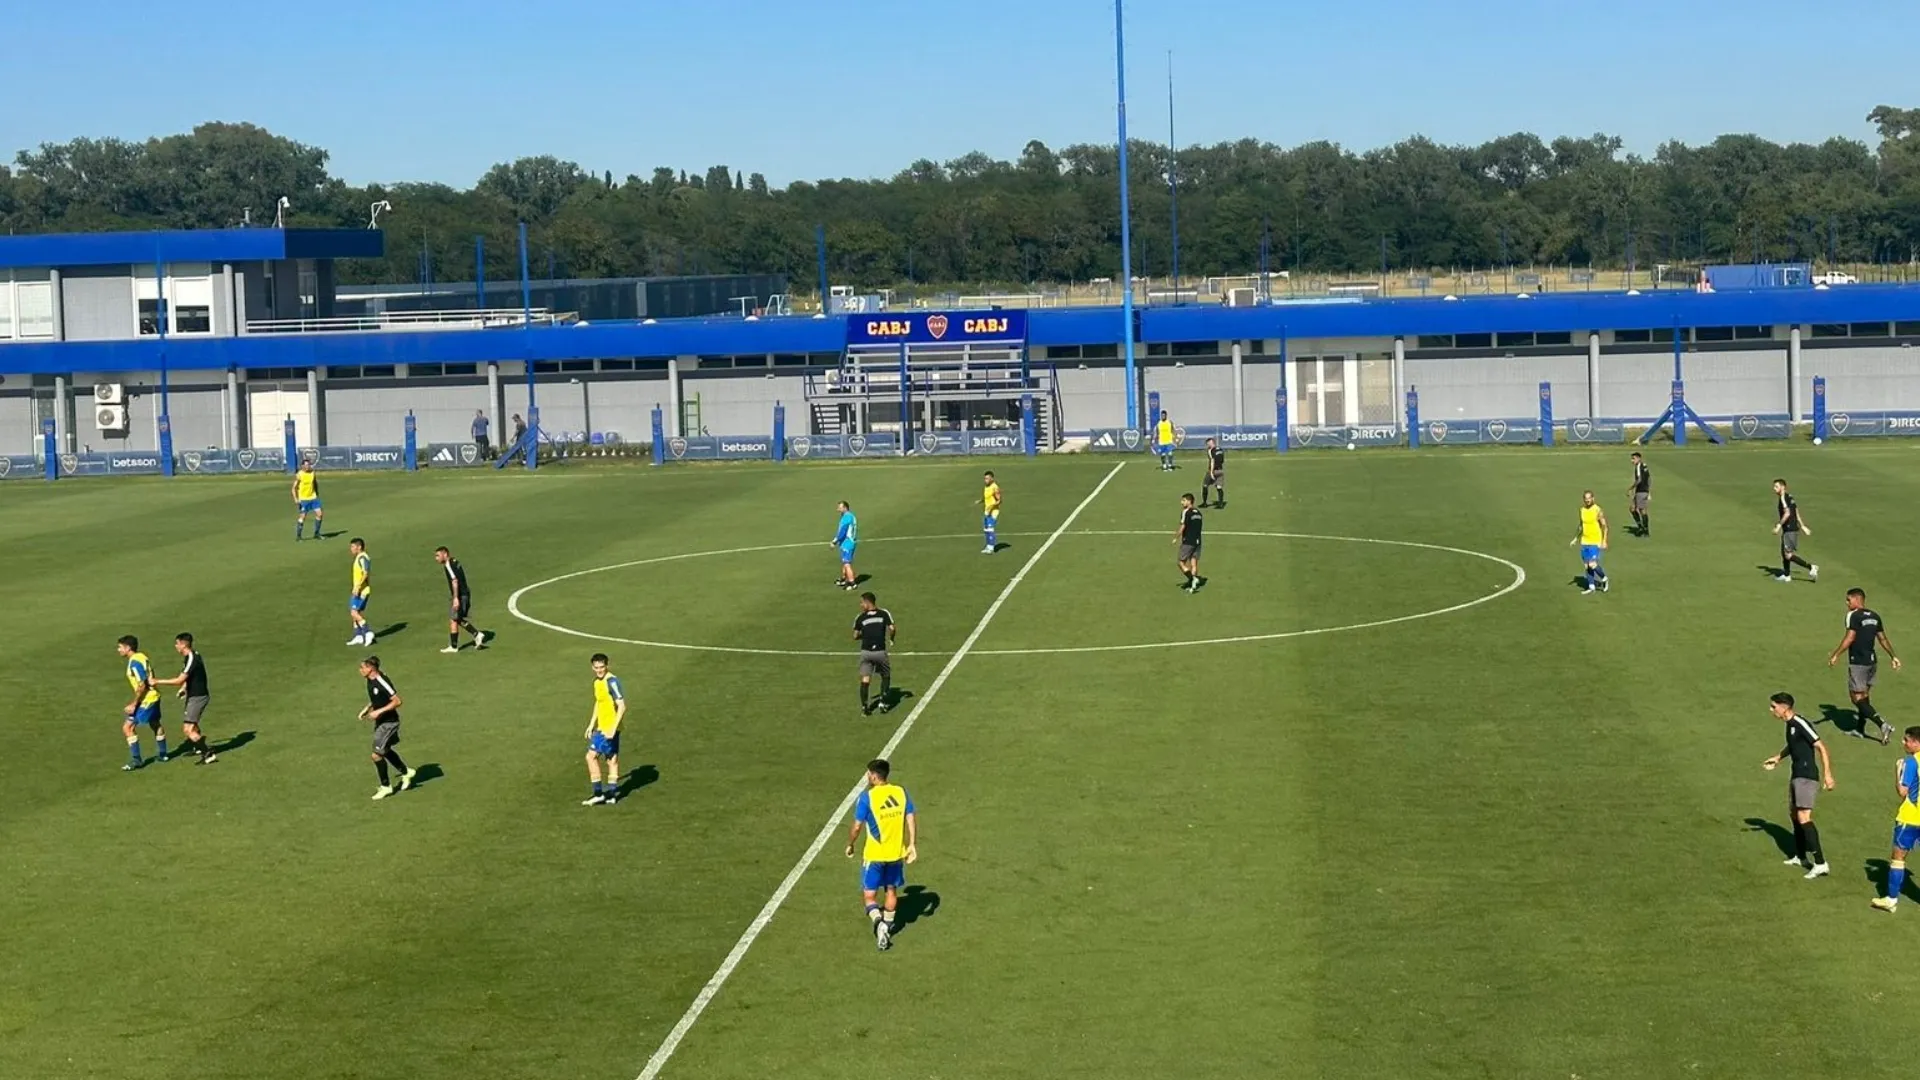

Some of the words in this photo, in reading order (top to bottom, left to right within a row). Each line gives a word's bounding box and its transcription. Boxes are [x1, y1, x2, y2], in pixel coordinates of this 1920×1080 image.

[867, 321, 911, 335] CABJ
[964, 318, 1008, 333] CABJ
[1222, 431, 1268, 442] betsson
[1351, 429, 1396, 439] DIRECTV
[722, 441, 766, 452] betsson
[973, 436, 1017, 448] DIRECTV
[113, 457, 156, 467] betsson
[355, 452, 398, 462] DIRECTV
